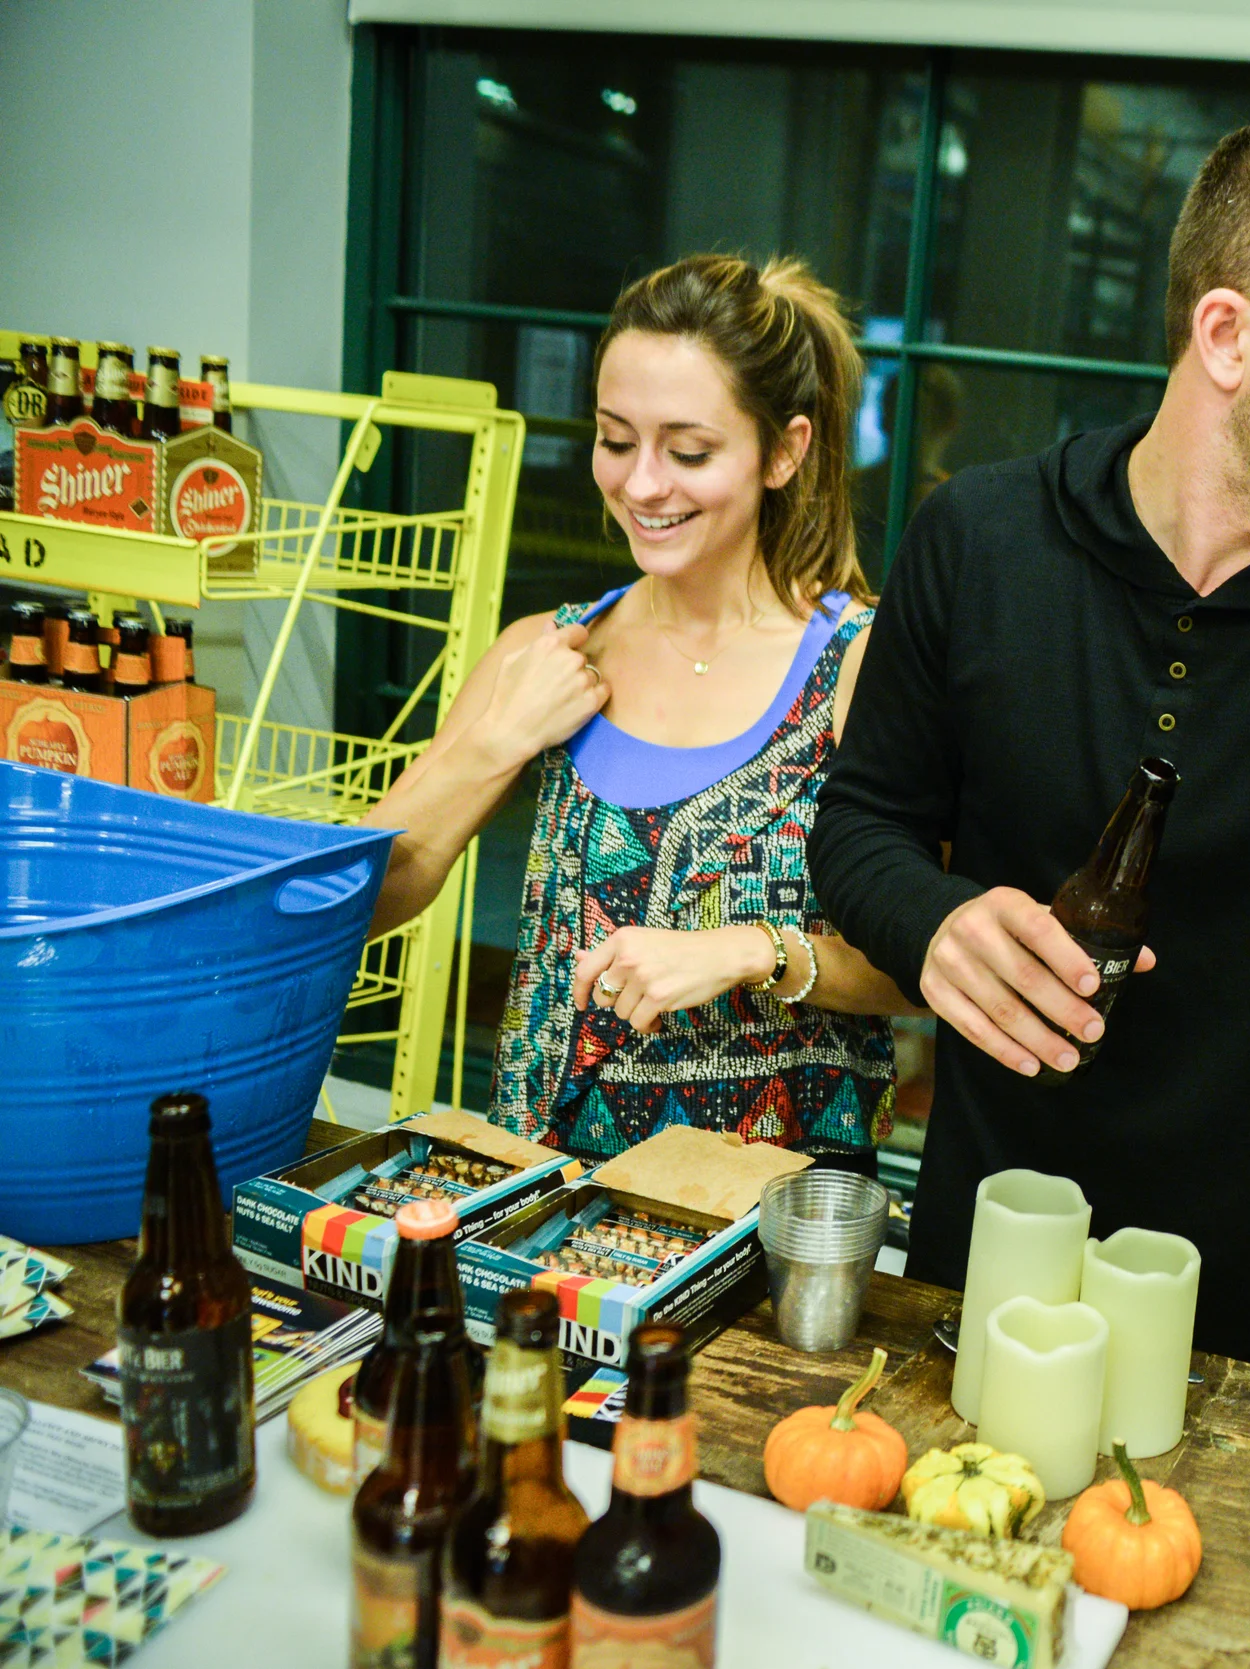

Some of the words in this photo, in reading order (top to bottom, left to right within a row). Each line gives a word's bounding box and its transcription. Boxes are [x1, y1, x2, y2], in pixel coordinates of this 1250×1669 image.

[38, 462, 132, 512] Shiner
[179, 484, 240, 518] Shiner
[20, 745, 78, 766] PUMPKIN
[1103, 959, 1130, 975] BIER
[236, 1195, 257, 1209] DARK
[257, 1202, 300, 1226] CHOCOLATE
[236, 1206, 255, 1220] NUTS
[255, 1213, 261, 1222] &
[261, 1215, 275, 1228] SEA
[276, 1221, 294, 1234] SALT
[462, 1218, 485, 1235] Thing
[493, 1208, 504, 1221] for
[504, 1201, 521, 1217] your
[304, 1246, 384, 1298] KIND
[456, 1262, 474, 1275] ARK
[474, 1267, 527, 1289] CHOCOLATE
[473, 1278, 480, 1287] &
[480, 1279, 498, 1293] SEA
[673, 1288, 691, 1307] KIND
[690, 1278, 708, 1295] Thing
[714, 1267, 724, 1278] for
[723, 1256, 736, 1273] your
[558, 1316, 622, 1364] IND
